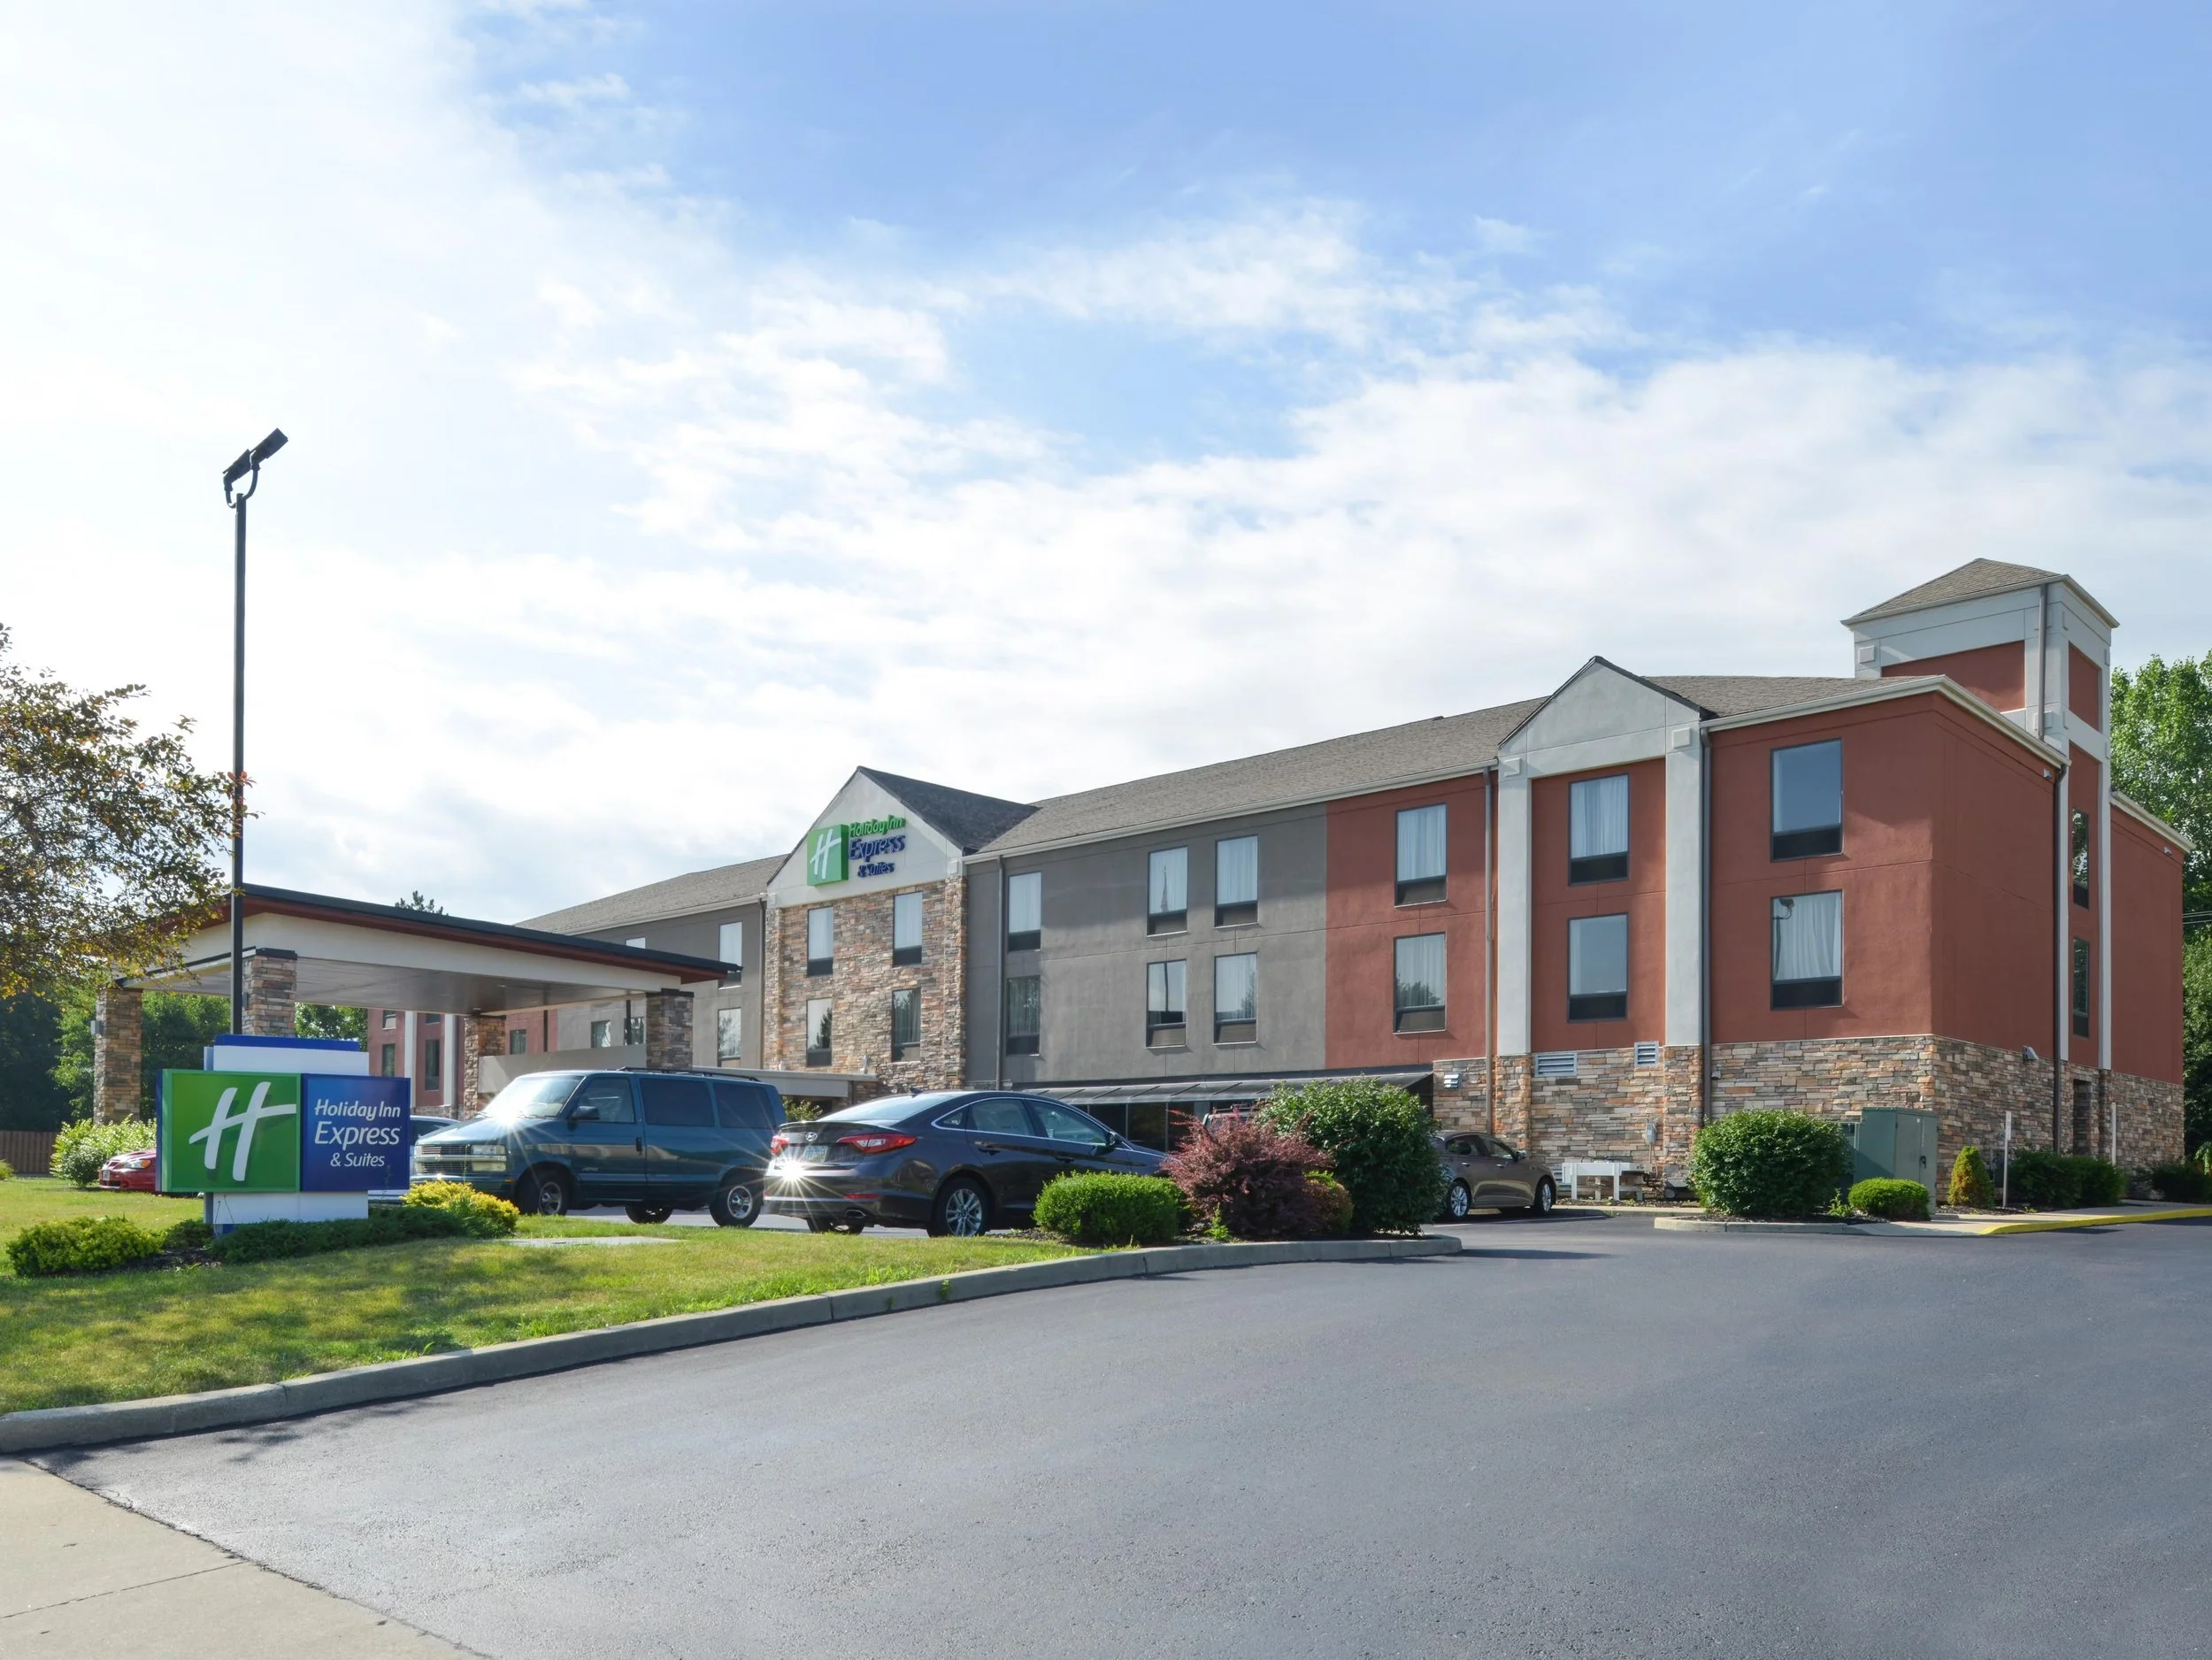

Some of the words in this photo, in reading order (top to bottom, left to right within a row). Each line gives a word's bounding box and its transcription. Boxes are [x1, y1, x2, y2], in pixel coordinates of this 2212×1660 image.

[849, 818, 887, 838] Holiday
[887, 814, 906, 830] Inn
[810, 828, 841, 880] H
[849, 834, 906, 862] Express
[857, 865, 867, 878] &
[866, 862, 895, 876] Suites
[314, 1099, 377, 1121] Holiday
[378, 1101, 401, 1118] Inn
[188, 1081, 296, 1181] H
[314, 1120, 401, 1150] Express
[330, 1152, 341, 1167] &
[343, 1152, 386, 1167] Suites
